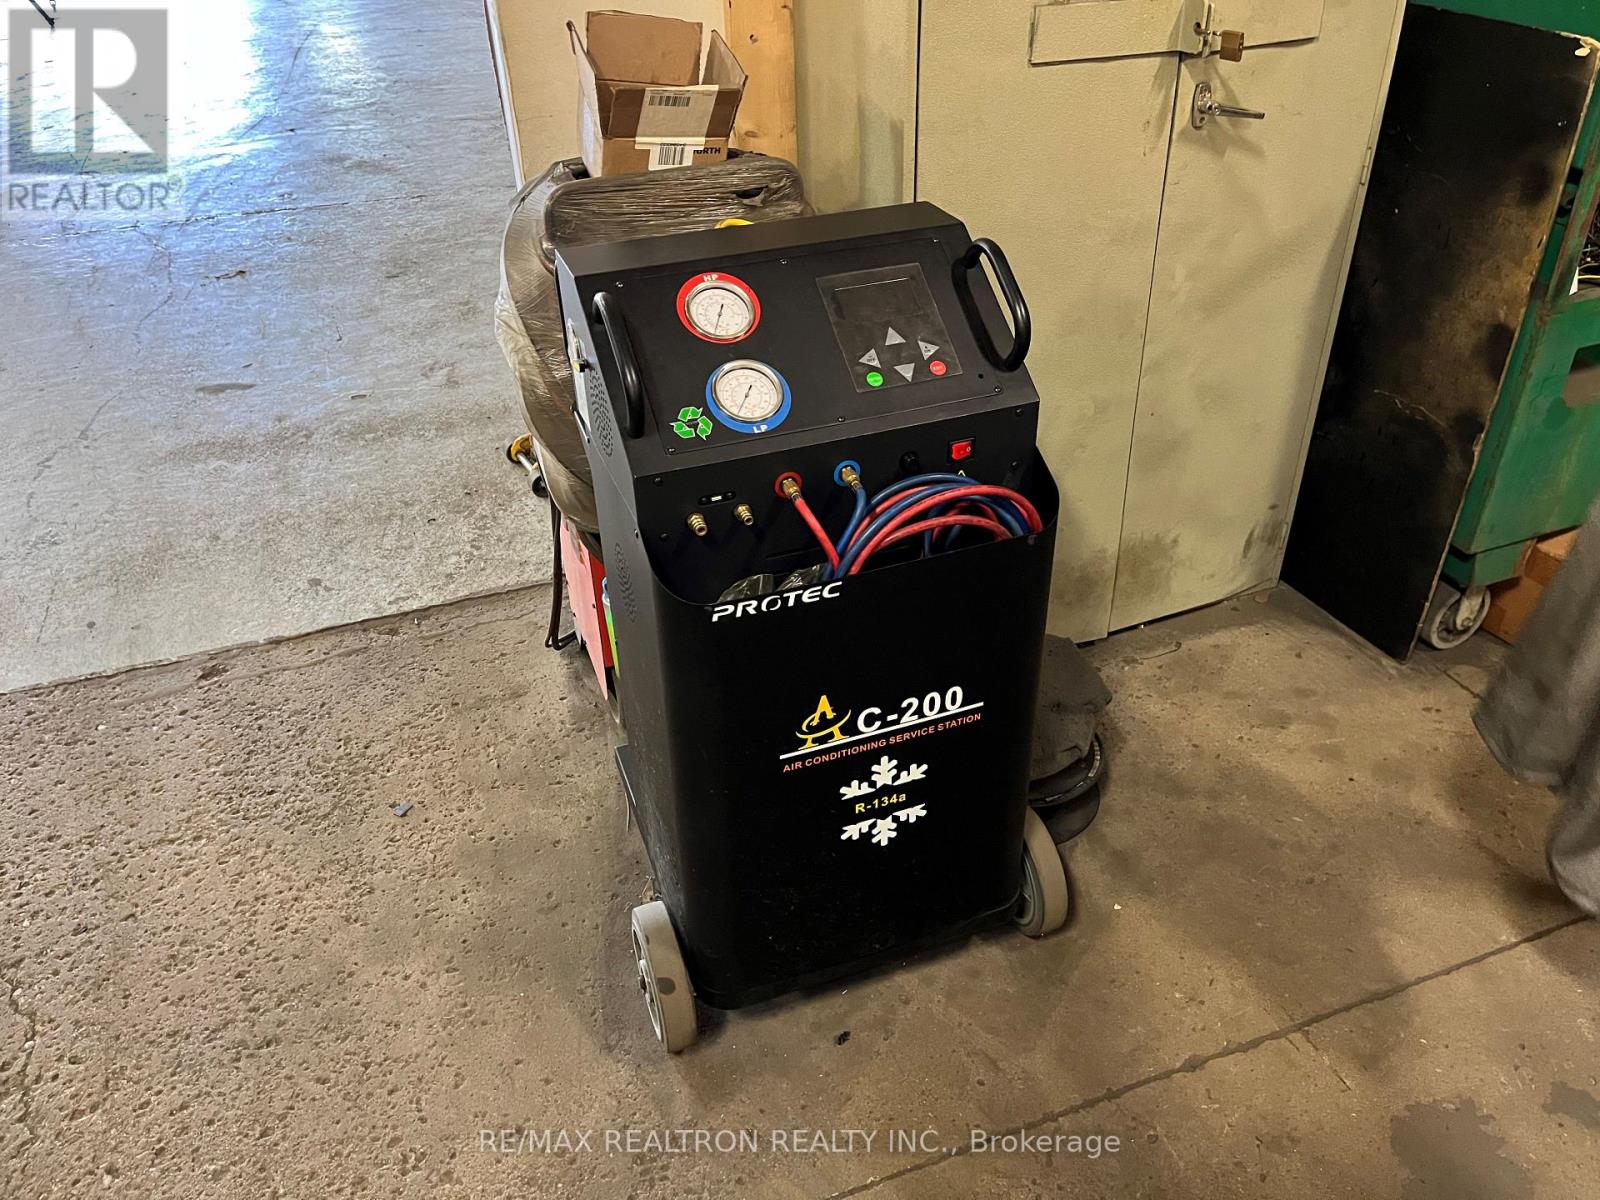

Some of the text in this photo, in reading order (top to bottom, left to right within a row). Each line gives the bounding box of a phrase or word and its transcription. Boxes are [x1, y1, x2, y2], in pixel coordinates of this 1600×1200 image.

[703, 274, 718, 282] HP
[753, 424, 768, 434] LP
[712, 581, 843, 622] PROTEC
[783, 713, 981, 773] AIR CONDITIONING SERVICE STATION
[855, 793, 907, 814] R-134a
